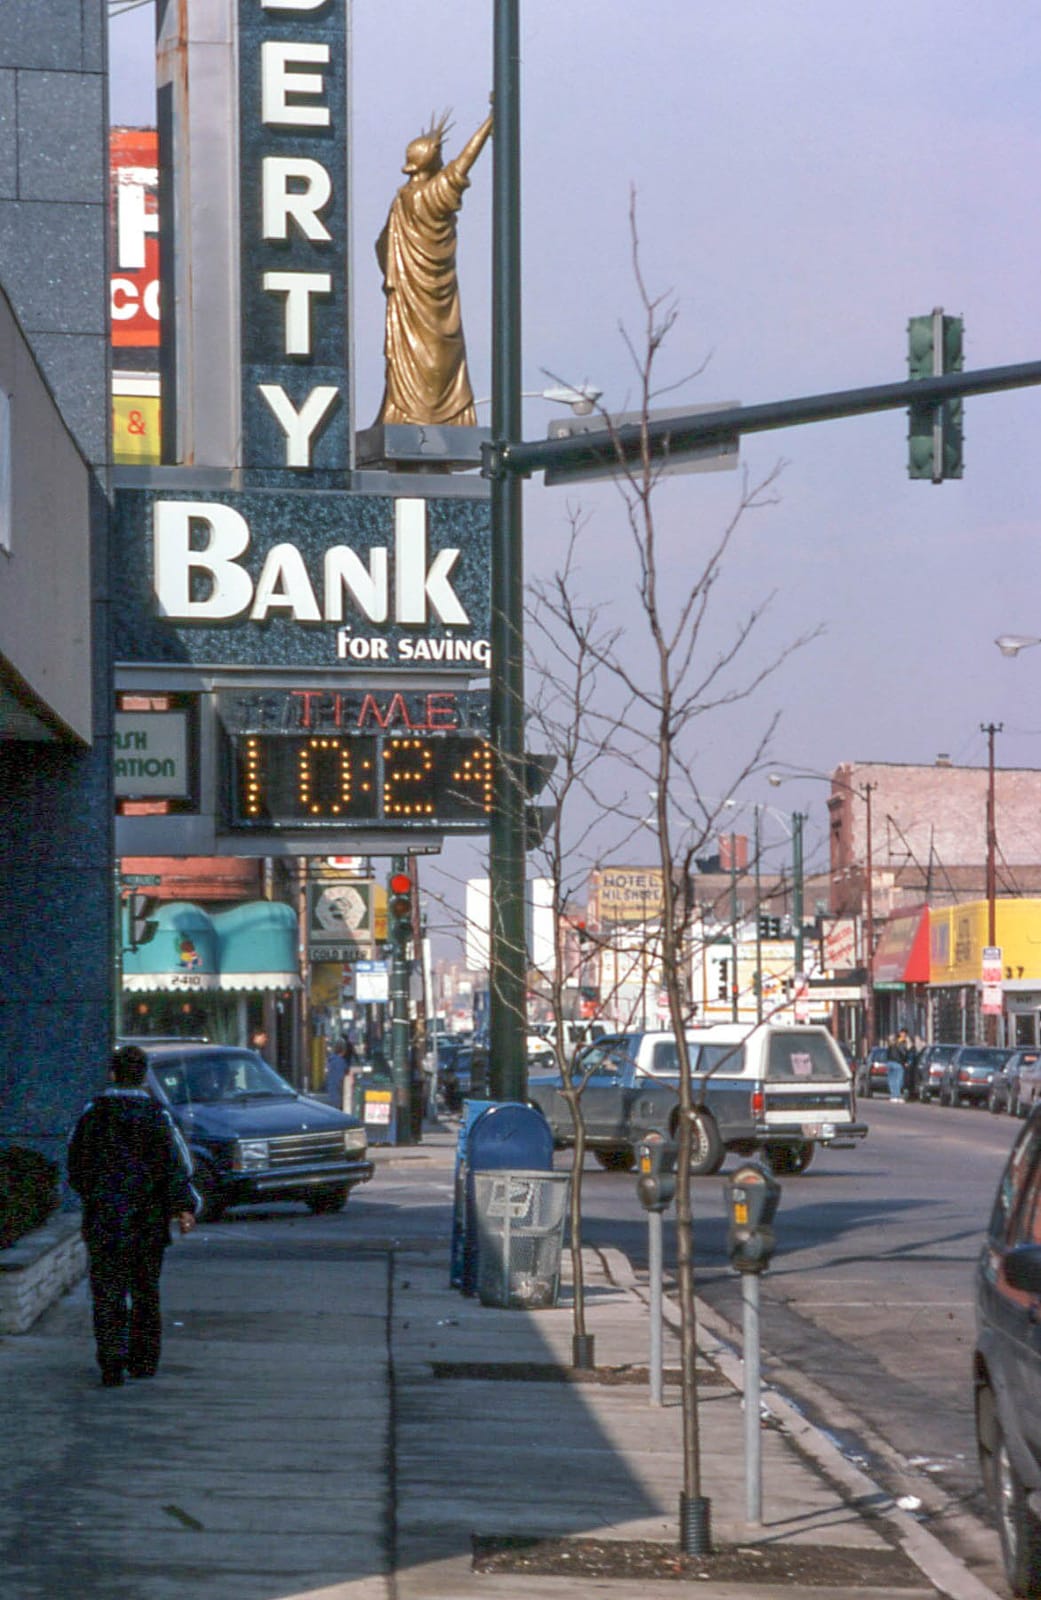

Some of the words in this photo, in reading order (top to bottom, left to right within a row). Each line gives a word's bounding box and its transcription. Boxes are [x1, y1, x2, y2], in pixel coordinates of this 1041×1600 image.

[257, 0, 339, 468] ERTY
[127, 410, 146, 435] &
[291, 690, 457, 730] TIME
[247, 739, 493, 814] 10:24
[603, 874, 659, 889] HOTEL
